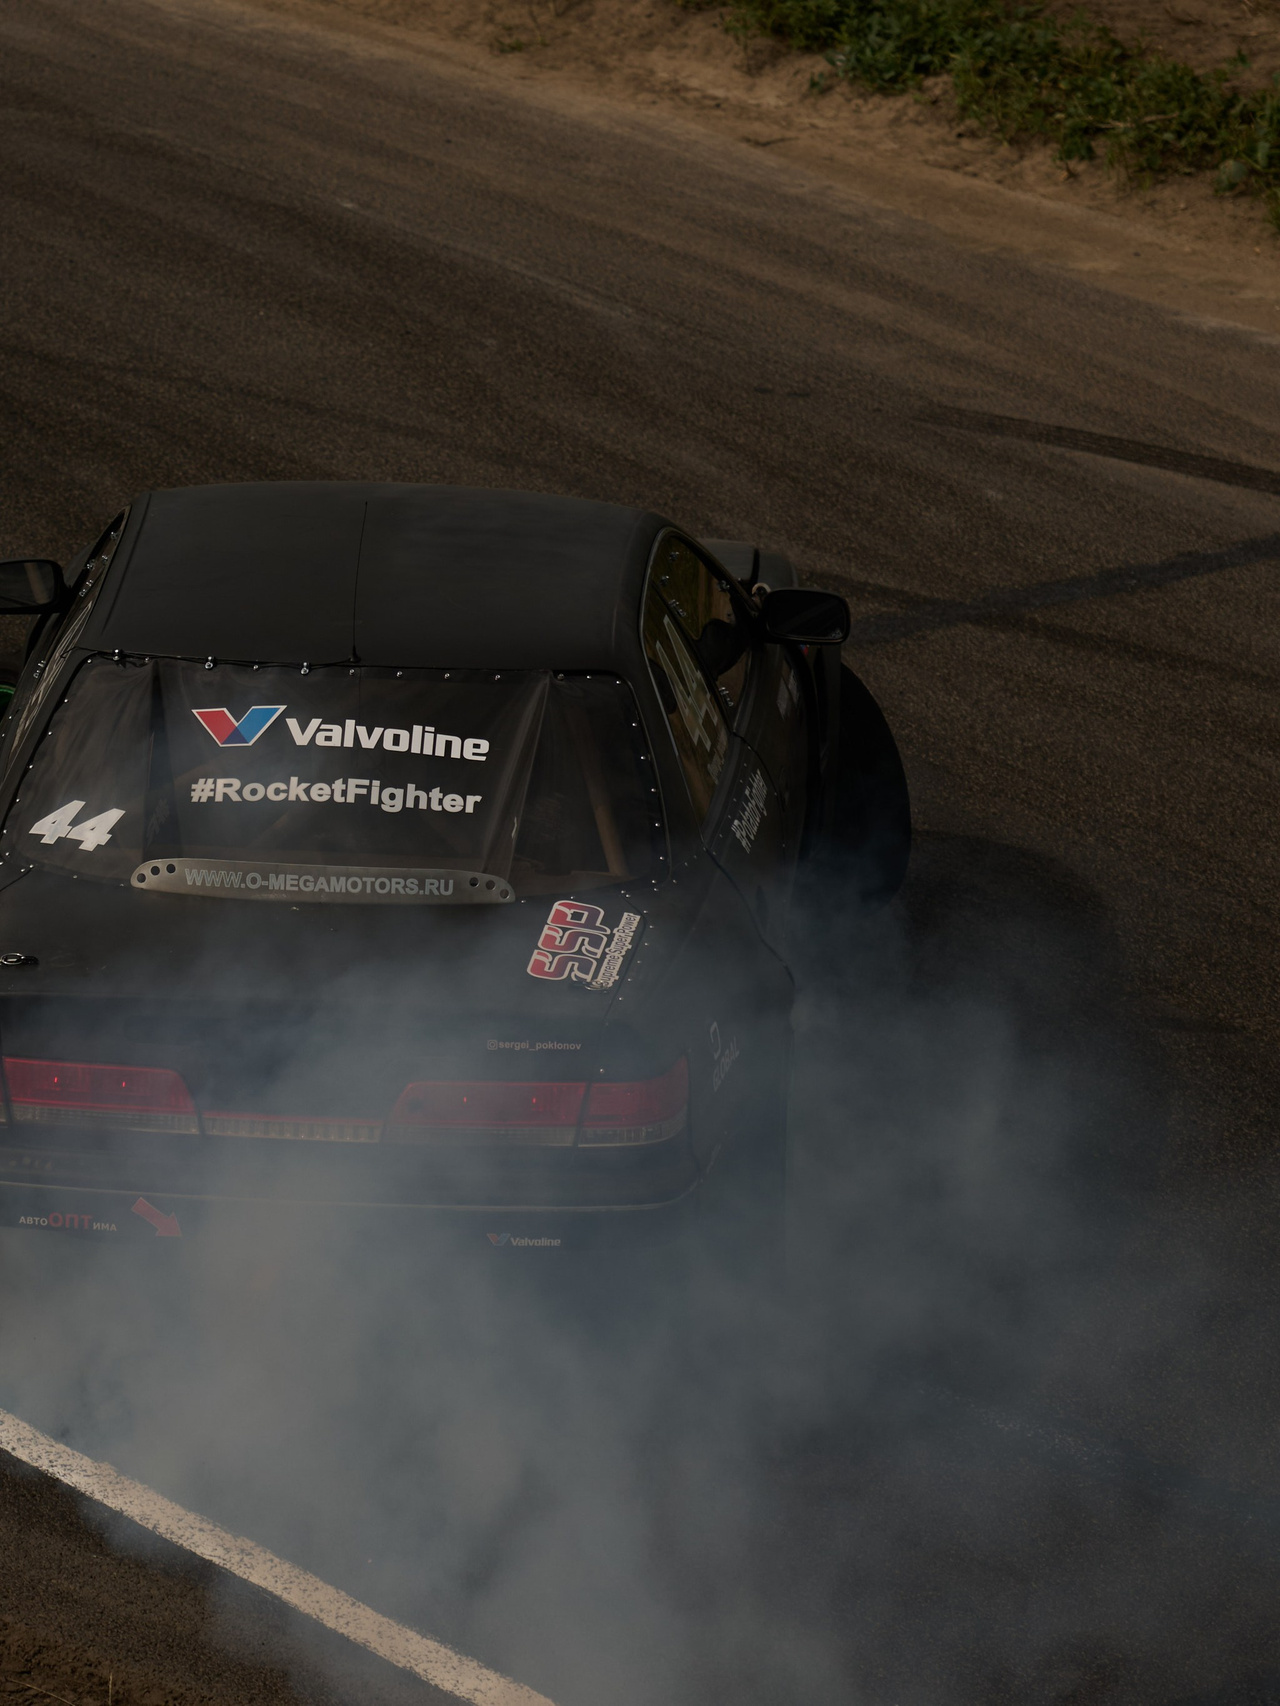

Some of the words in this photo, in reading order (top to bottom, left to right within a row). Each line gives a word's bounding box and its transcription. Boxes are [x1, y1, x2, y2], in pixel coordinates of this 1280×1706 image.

[285, 717, 491, 762] Valvoline
[190, 776, 483, 814] #RocketFighter
[28, 799, 127, 852] 44
[185, 868, 455, 897] WWW.O-MEGAMOTORS.RU
[618, 913, 638, 934] Power
[526, 899, 611, 983] SSP
[608, 934, 628, 956] Super
[599, 952, 621, 987] Supreme
[498, 1040, 582, 1051] sergei_poklonov
[18, 1211, 118, 1232] АВТООПТИМА
[510, 1236, 562, 1247] Valvoline
